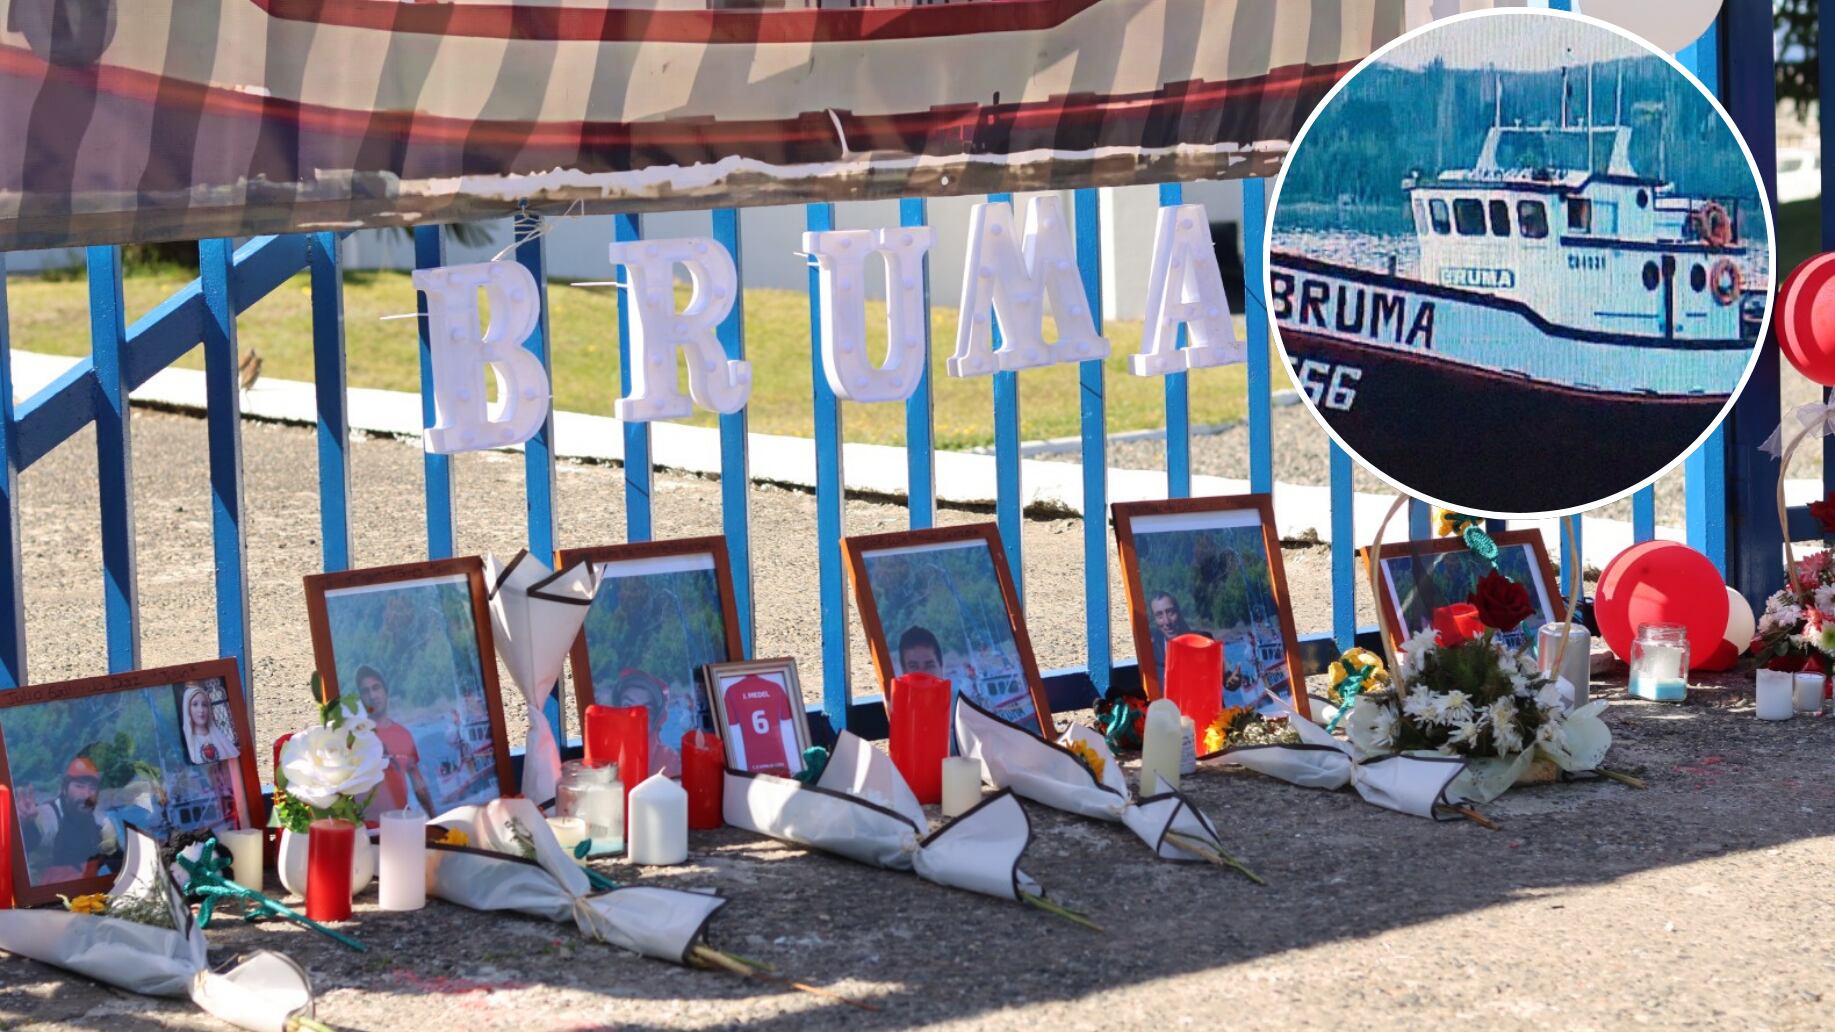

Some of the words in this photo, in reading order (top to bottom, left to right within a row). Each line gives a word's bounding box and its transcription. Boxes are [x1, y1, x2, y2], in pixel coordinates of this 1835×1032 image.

[1443, 268, 1512, 287] BRUMA
[412, 196, 1245, 454] BRUMA
[1270, 271, 1435, 349] BRUMA
[1287, 356, 1362, 412] 66
[751, 709, 770, 735] 6
